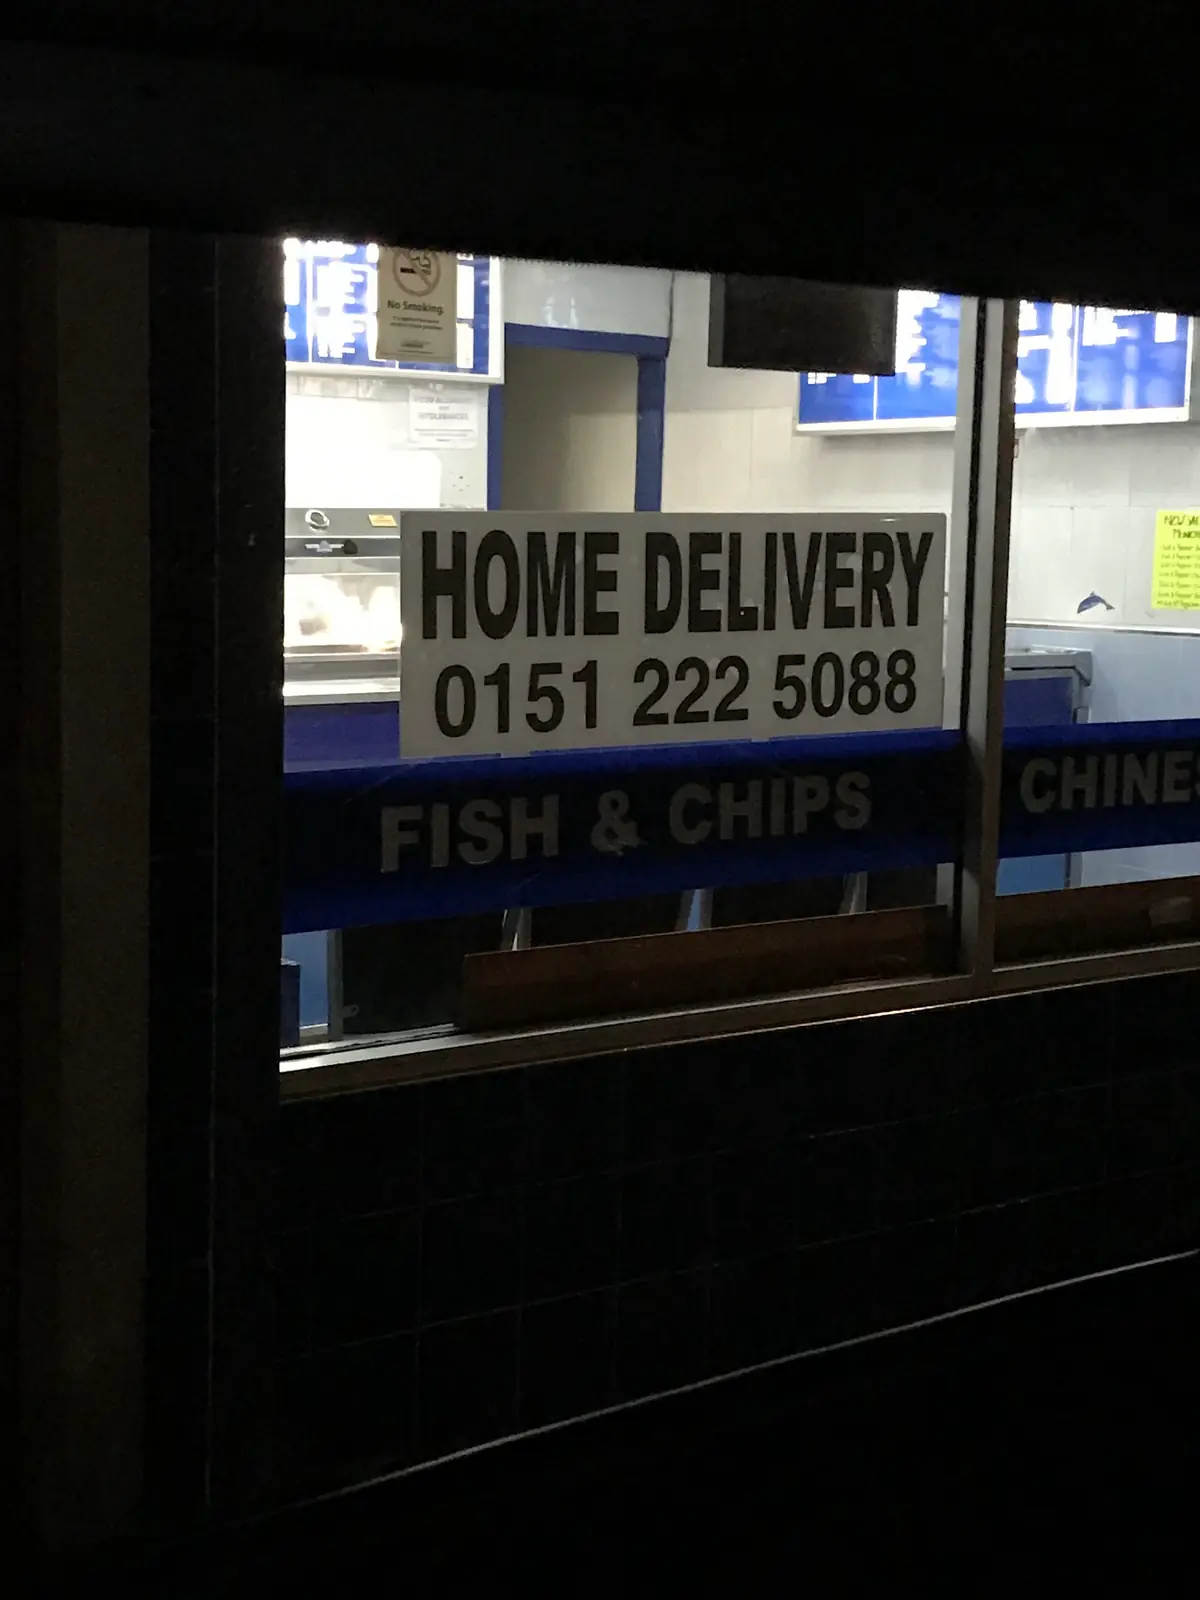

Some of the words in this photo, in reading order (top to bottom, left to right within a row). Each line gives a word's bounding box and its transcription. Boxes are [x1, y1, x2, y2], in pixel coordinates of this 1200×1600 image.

[387, 300, 401, 310] No
[403, 301, 444, 316] Smoking
[421, 529, 620, 640] HOME
[643, 531, 934, 635] DELIVERY
[434, 659, 599, 738] 0151
[632, 655, 751, 726] 222
[772, 649, 917, 720] 5088
[379, 793, 560, 874] FISH
[590, 789, 645, 857] &
[668, 771, 873, 846] CHIPS
[1020, 749, 1200, 814] CHINE
